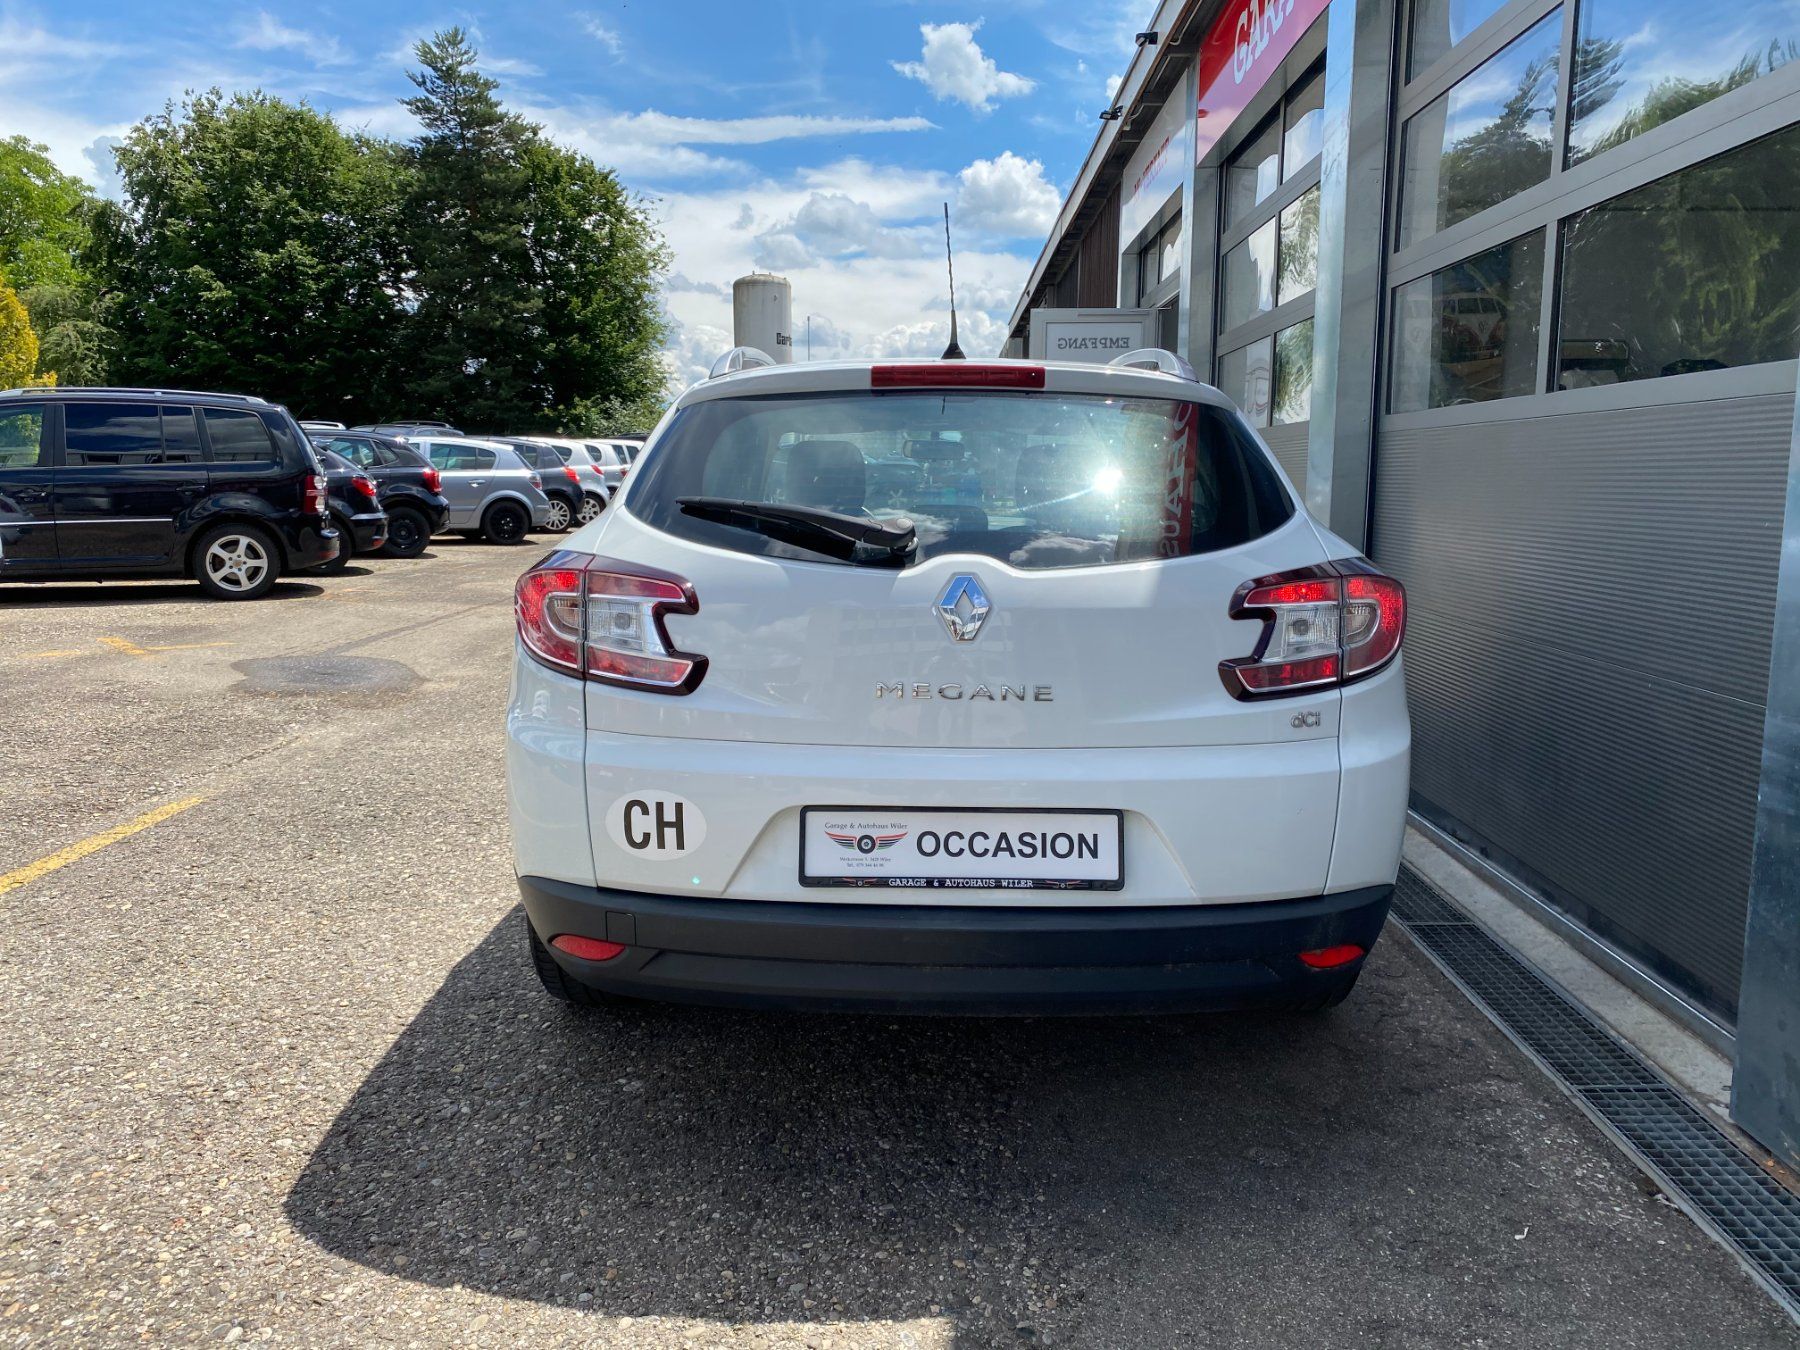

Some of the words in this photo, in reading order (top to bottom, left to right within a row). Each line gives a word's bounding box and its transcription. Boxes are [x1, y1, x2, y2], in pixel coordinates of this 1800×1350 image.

[1233, 0, 1294, 85] GAR
[874, 681, 1054, 702] MEGANE
[623, 799, 685, 850] CH
[824, 822, 848, 831] Garage
[916, 830, 1099, 859] OCCASION
[888, 878, 927, 887] GARAGE
[944, 879, 996, 887] AUTOHAUS
[1001, 879, 1034, 888] WILER
